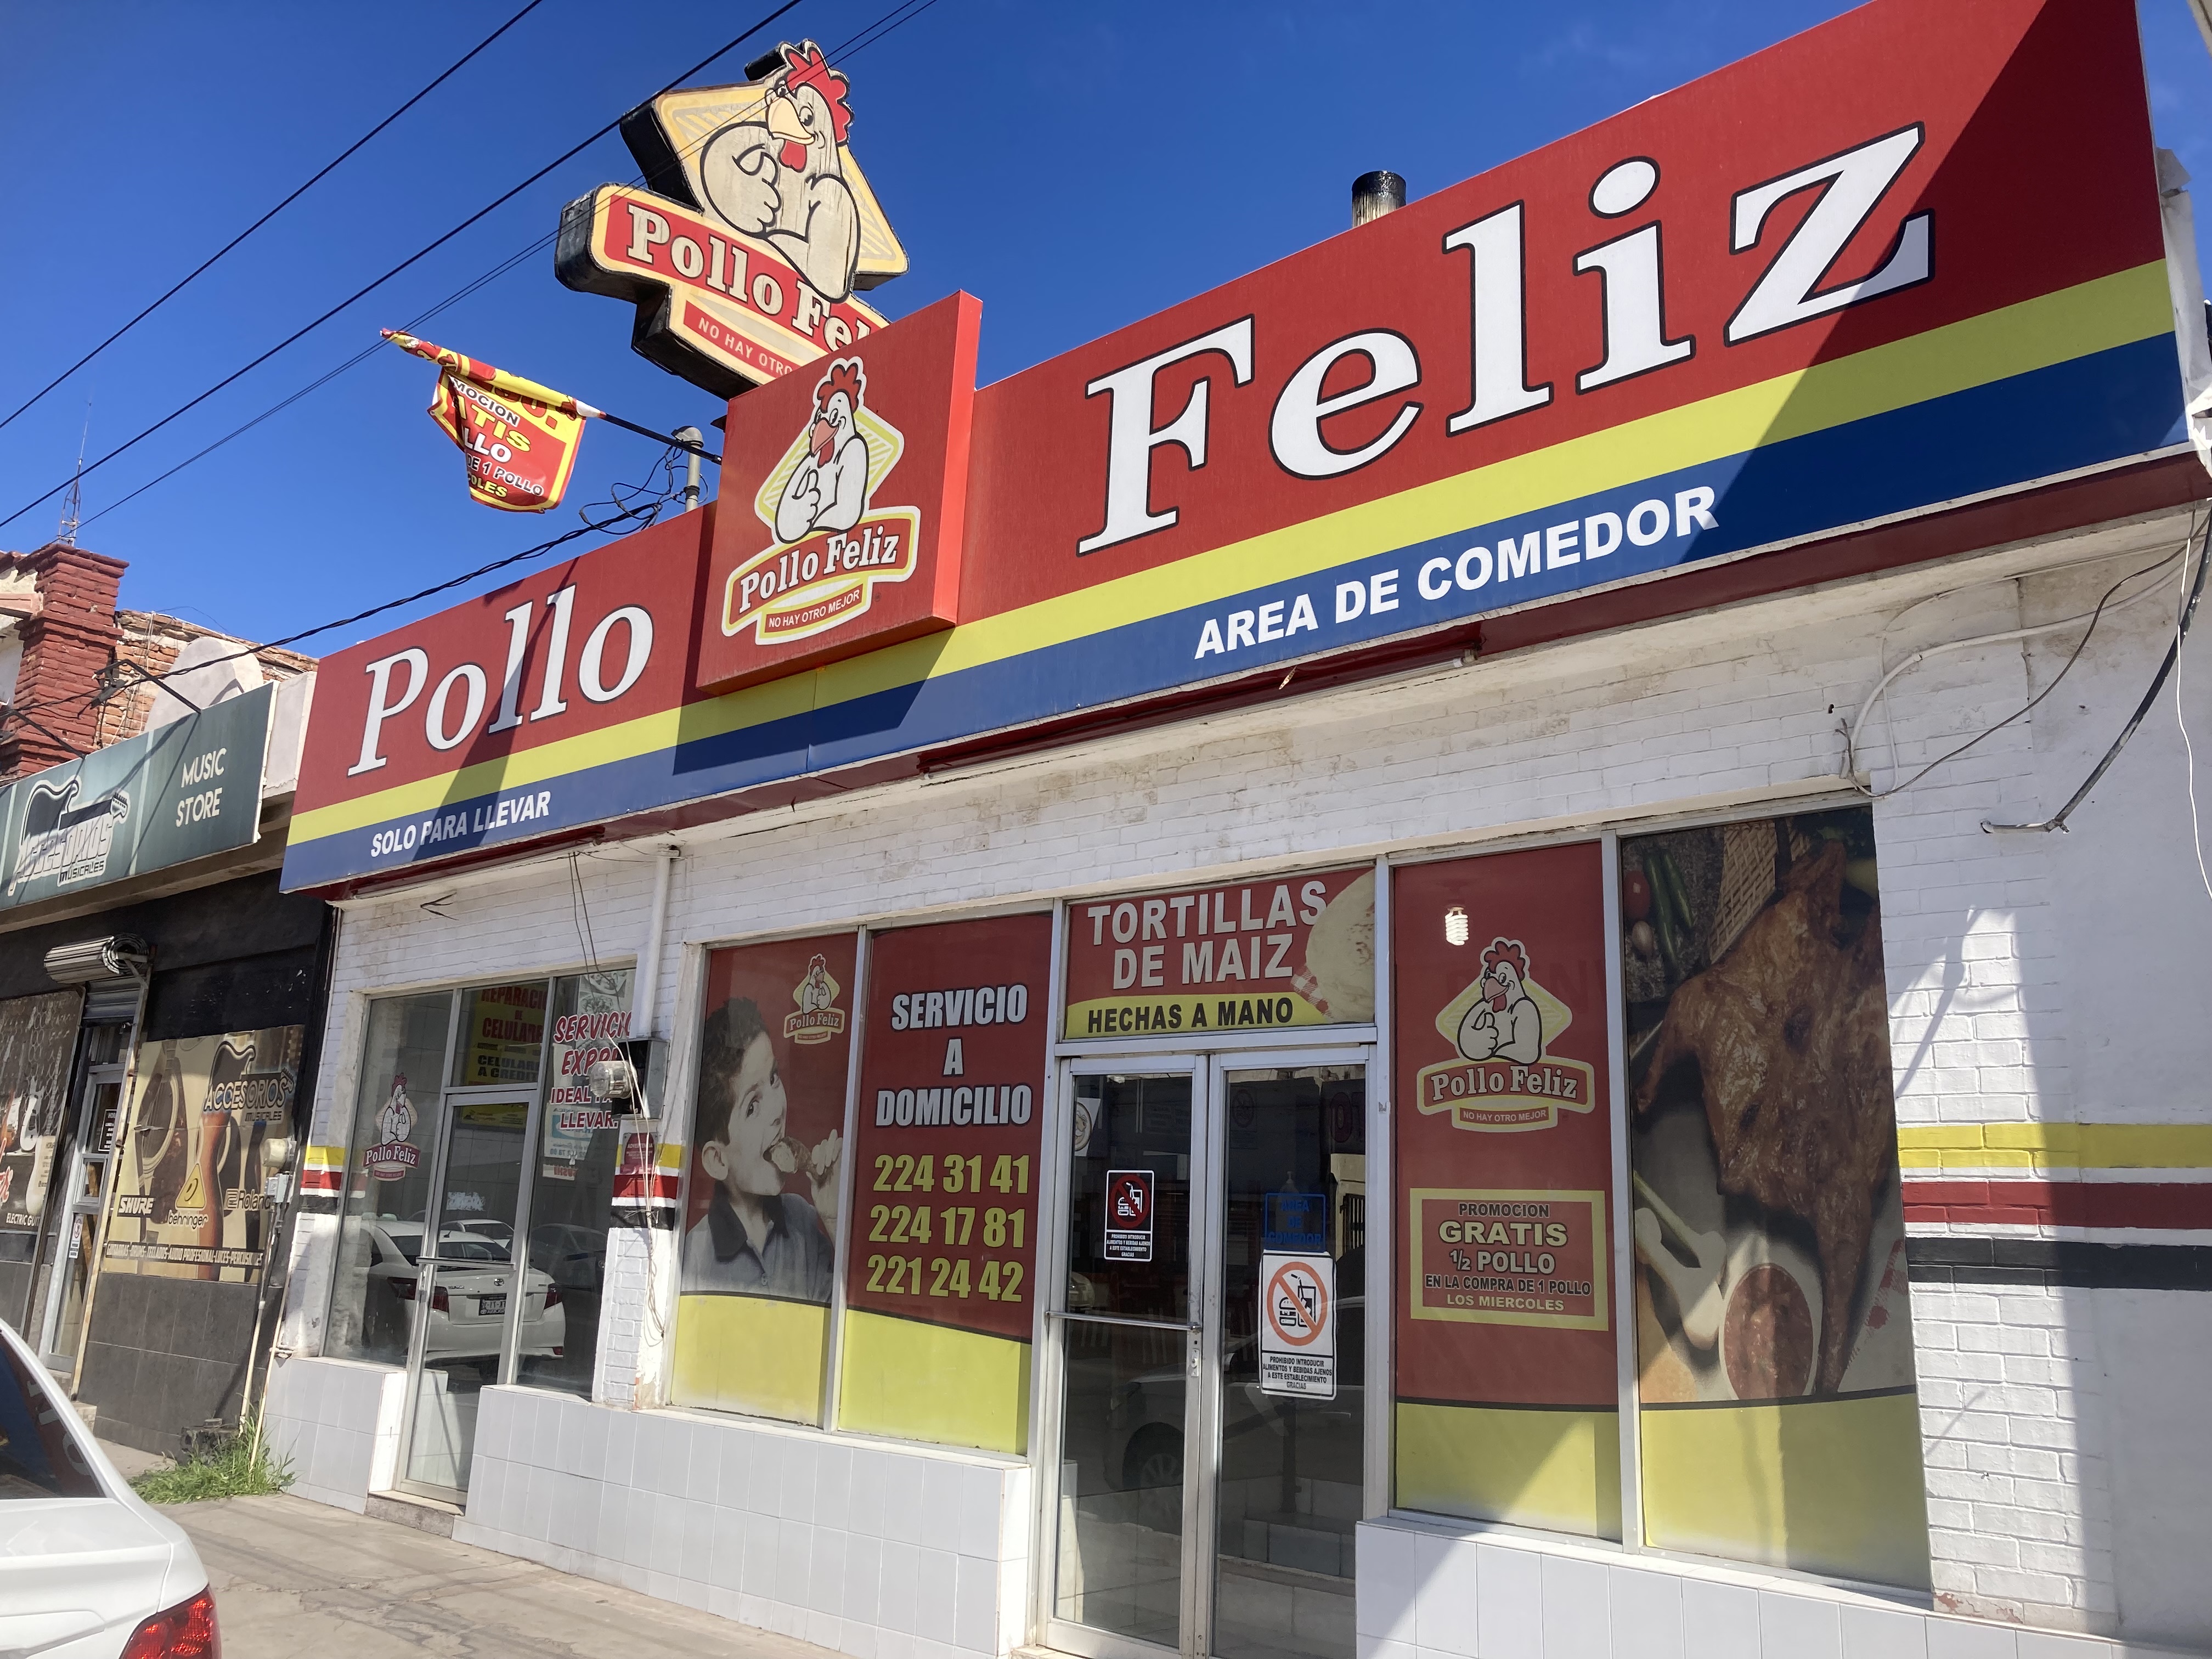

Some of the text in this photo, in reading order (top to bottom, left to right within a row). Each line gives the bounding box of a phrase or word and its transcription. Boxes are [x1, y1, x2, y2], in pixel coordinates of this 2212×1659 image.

[627, 203, 871, 352] Pollo Fel
[698, 316, 793, 376] NO HAY OTRO
[1077, 120, 1935, 555] Feliz
[451, 376, 520, 427] MOCION
[463, 427, 512, 463] LLO
[483, 461, 492, 475] 1
[493, 466, 544, 496] POLLO
[738, 525, 900, 614] Pollo Feliz
[1194, 486, 1718, 659] AREA DE COMEDOR
[769, 589, 860, 628] NO HAY OTRO MEJOR
[347, 582, 654, 777] Pollo
[181, 748, 225, 788] MUSIC
[176, 787, 223, 828] STORE
[371, 791, 551, 857] SOLO PARA LLEVAR
[59, 860, 105, 883] MUSICALES
[1087, 881, 1327, 946] TORTILLAS
[1113, 933, 1294, 990] DE MAIZ
[789, 1013, 839, 1031] Pollo Feliz
[891, 983, 1028, 1031] SERVICIO
[1088, 997, 1293, 1034] HECHAS A MANO
[483, 1018, 544, 1043] CELULARE
[943, 1038, 963, 1076] A
[490, 1068, 538, 1082] CREDIT
[1431, 1065, 1578, 1102] Pollo Feliz
[204, 1077, 287, 1111] ACCESORIOS
[550, 1086, 591, 1105] IDEAL
[876, 1085, 1032, 1127] DOMICILIO
[559, 1110, 618, 1130] LLEVAR.
[1463, 1109, 1547, 1122] NO HAY OTRO MEJOR
[365, 1145, 416, 1165] Pollo Feliz
[873, 1154, 1030, 1195] 224 31 41
[6, 1212, 41, 1227] ELECTRIC GUIT
[118, 1197, 154, 1215] SHURE
[167, 1210, 208, 1231] behringer
[1281, 1199, 1310, 1211] AREA
[1458, 1203, 1550, 1218] PROMOCION
[868, 1204, 1026, 1249] 224 17 81
[1268, 1232, 1321, 1245] COMEDOR
[1438, 1220, 1568, 1247] GRATIS
[866, 1254, 1024, 1302] 221 24 42
[1477, 1250, 1556, 1274] POLLO
[1425, 1274, 1591, 1296] EN LA COMPRA DE 1 POLLO
[1447, 1294, 1565, 1312] LOS MIERCOLES
[1263, 1363, 1288, 1372] ALIMENTOS
[1270, 1356, 1324, 1367] PROHIBIDO INTRODUCIR
[1284, 1373, 1327, 1383] ESTABLECIMIENTO
[1286, 1381, 1306, 1390] GRACIAS
